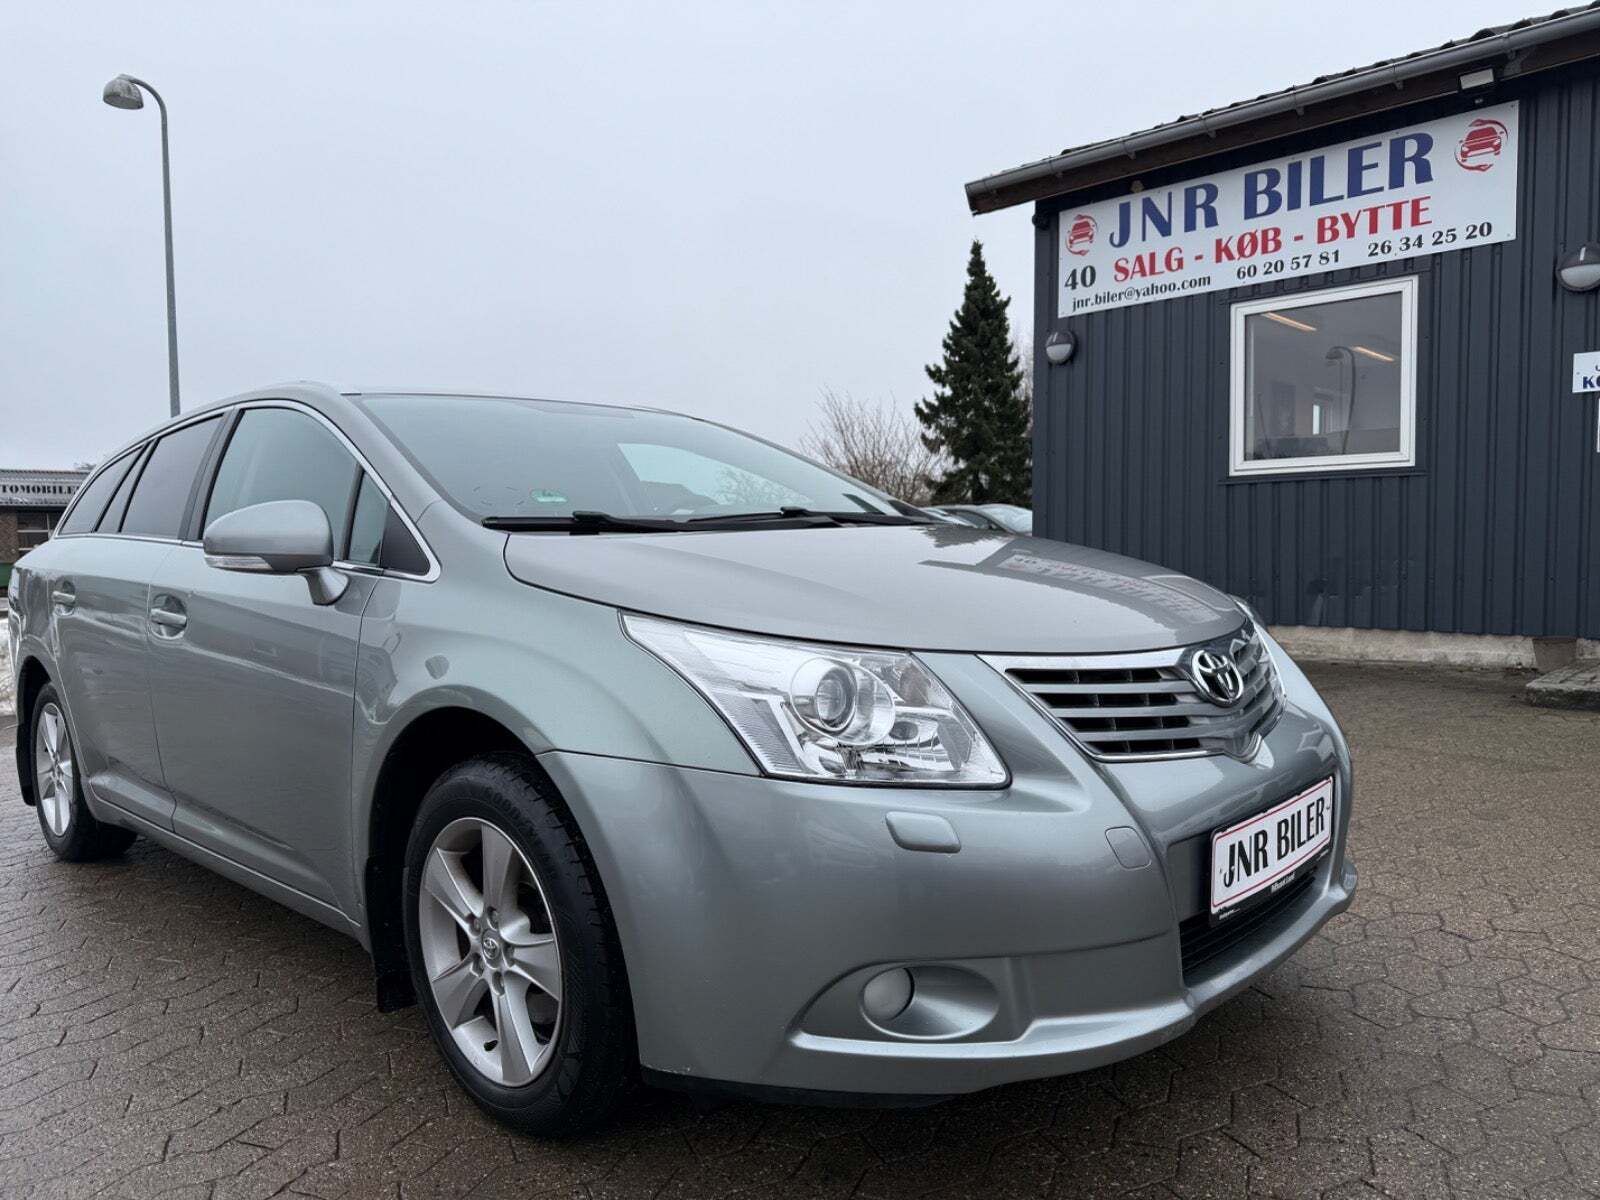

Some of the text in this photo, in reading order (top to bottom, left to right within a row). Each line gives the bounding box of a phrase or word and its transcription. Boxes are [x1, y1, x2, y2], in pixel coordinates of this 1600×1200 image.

[1109, 132, 1433, 248] JNR BILER
[1113, 247, 1184, 283] SALG
[1215, 226, 1282, 264] KØB
[1317, 196, 1433, 245] BYTTE
[1367, 221, 1493, 257] 26 34 25 20
[1064, 265, 1097, 291] 40
[1236, 249, 1340, 281] 60 20 57 81
[1072, 274, 1211, 312] jnr.biler@yahoo.com
[1, 484, 79, 495] TOMOBILE
[1223, 796, 1325, 888] JNR BILER
